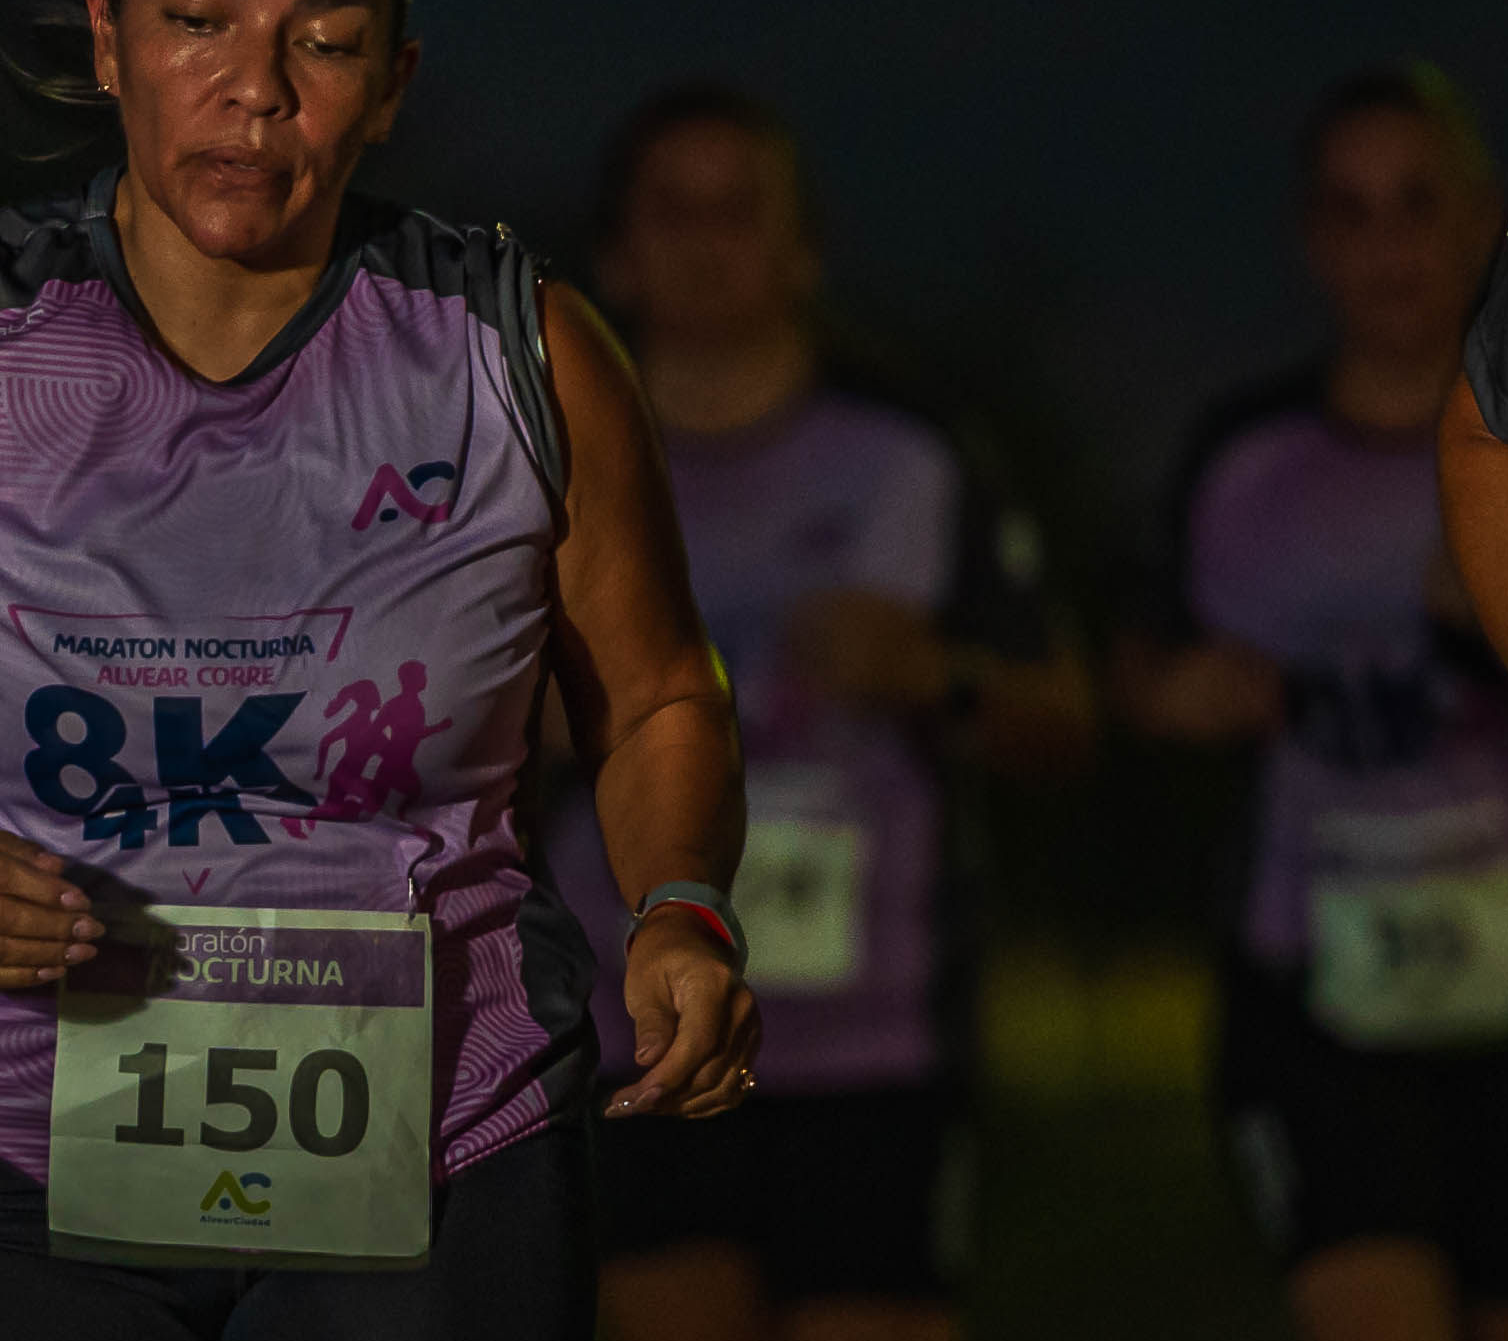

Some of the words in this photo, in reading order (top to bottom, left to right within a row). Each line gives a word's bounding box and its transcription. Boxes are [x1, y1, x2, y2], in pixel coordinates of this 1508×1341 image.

[52, 633, 176, 659] MARATON
[183, 635, 316, 660] NOCTURNA
[96, 665, 190, 687] ALVEAR
[196, 666, 276, 687] CORRE
[24, 684, 320, 816] 8K
[83, 784, 273, 851] 4K
[175, 927, 266, 956] aratón
[176, 956, 345, 988] OCTURNA
[115, 1041, 371, 1158] 150
